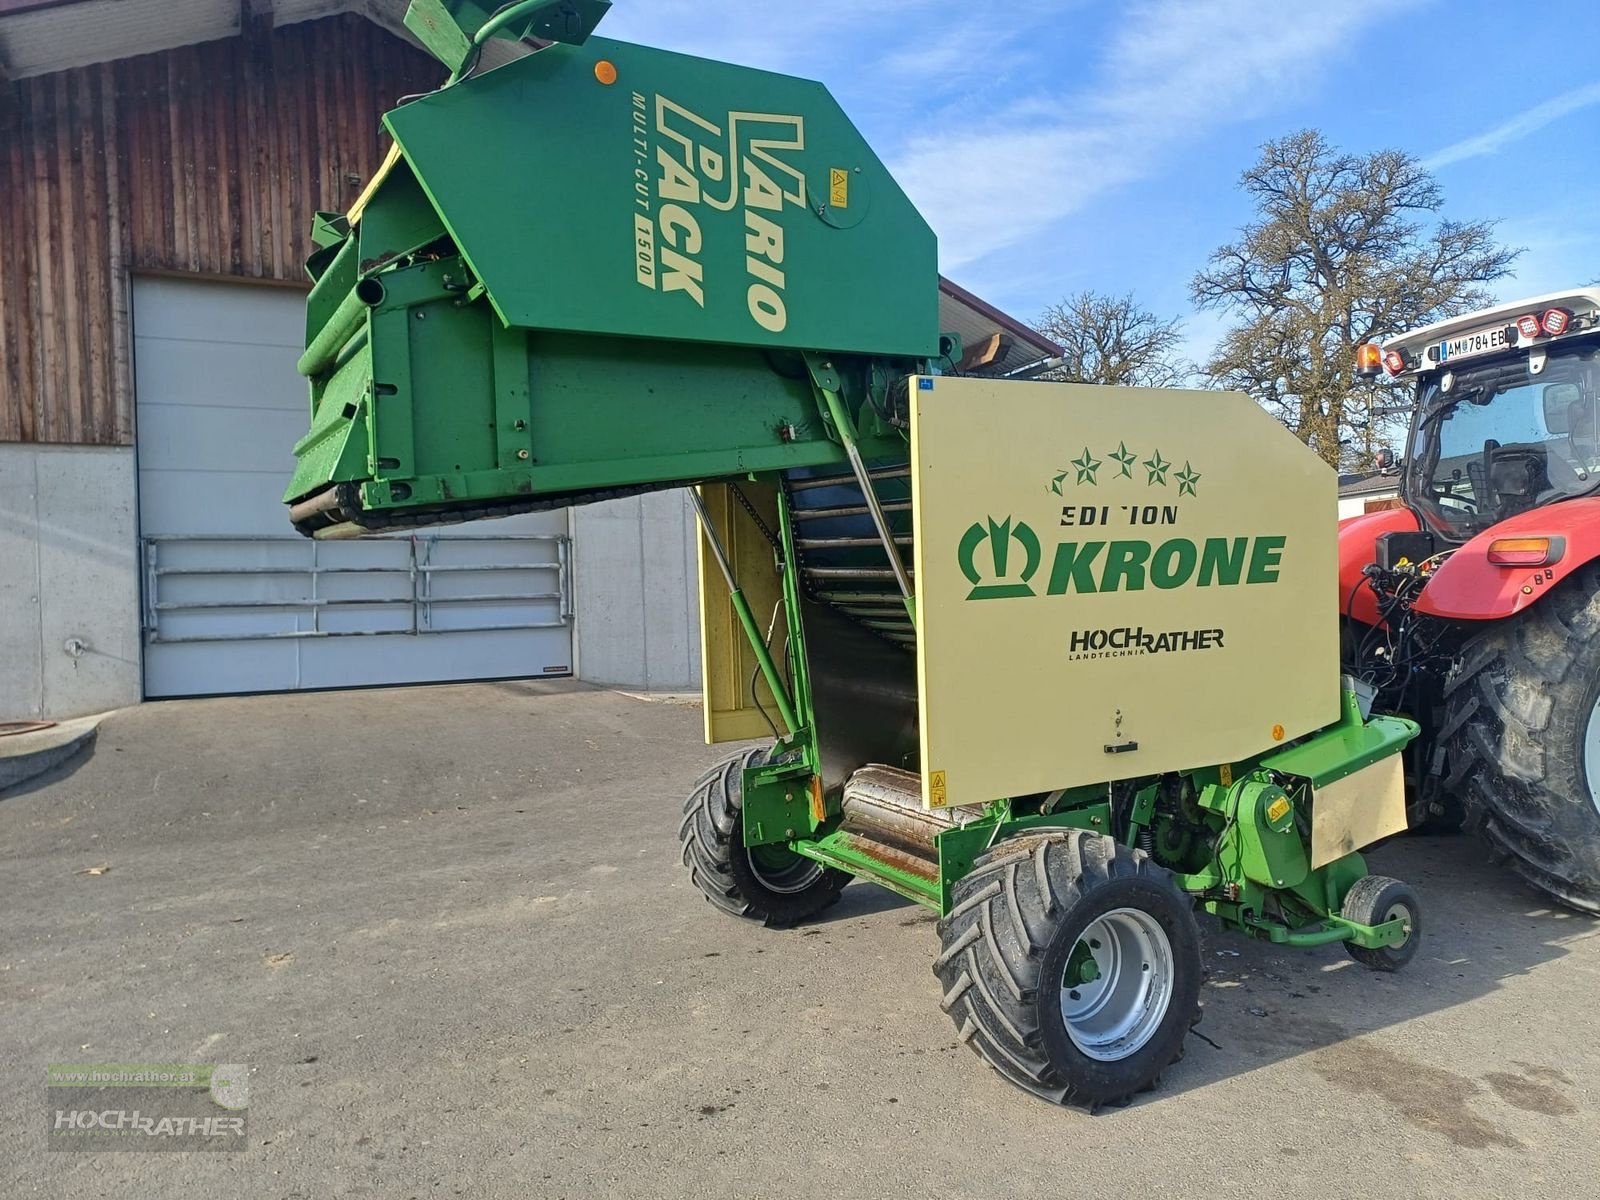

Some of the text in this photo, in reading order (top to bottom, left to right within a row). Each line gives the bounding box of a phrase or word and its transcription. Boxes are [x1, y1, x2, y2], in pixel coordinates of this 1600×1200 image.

[632, 91, 652, 275] MULTI-CUT 1500
[656, 94, 732, 308] PACK
[732, 111, 807, 332] VARIO
[1448, 330, 1504, 357] AM 784 EB
[1060, 506, 1178, 526] EDIION
[1046, 536, 1287, 596] KRONE
[1069, 649, 1145, 661] LANDTECHNIK
[1070, 627, 1224, 653] HOCHRATHER
